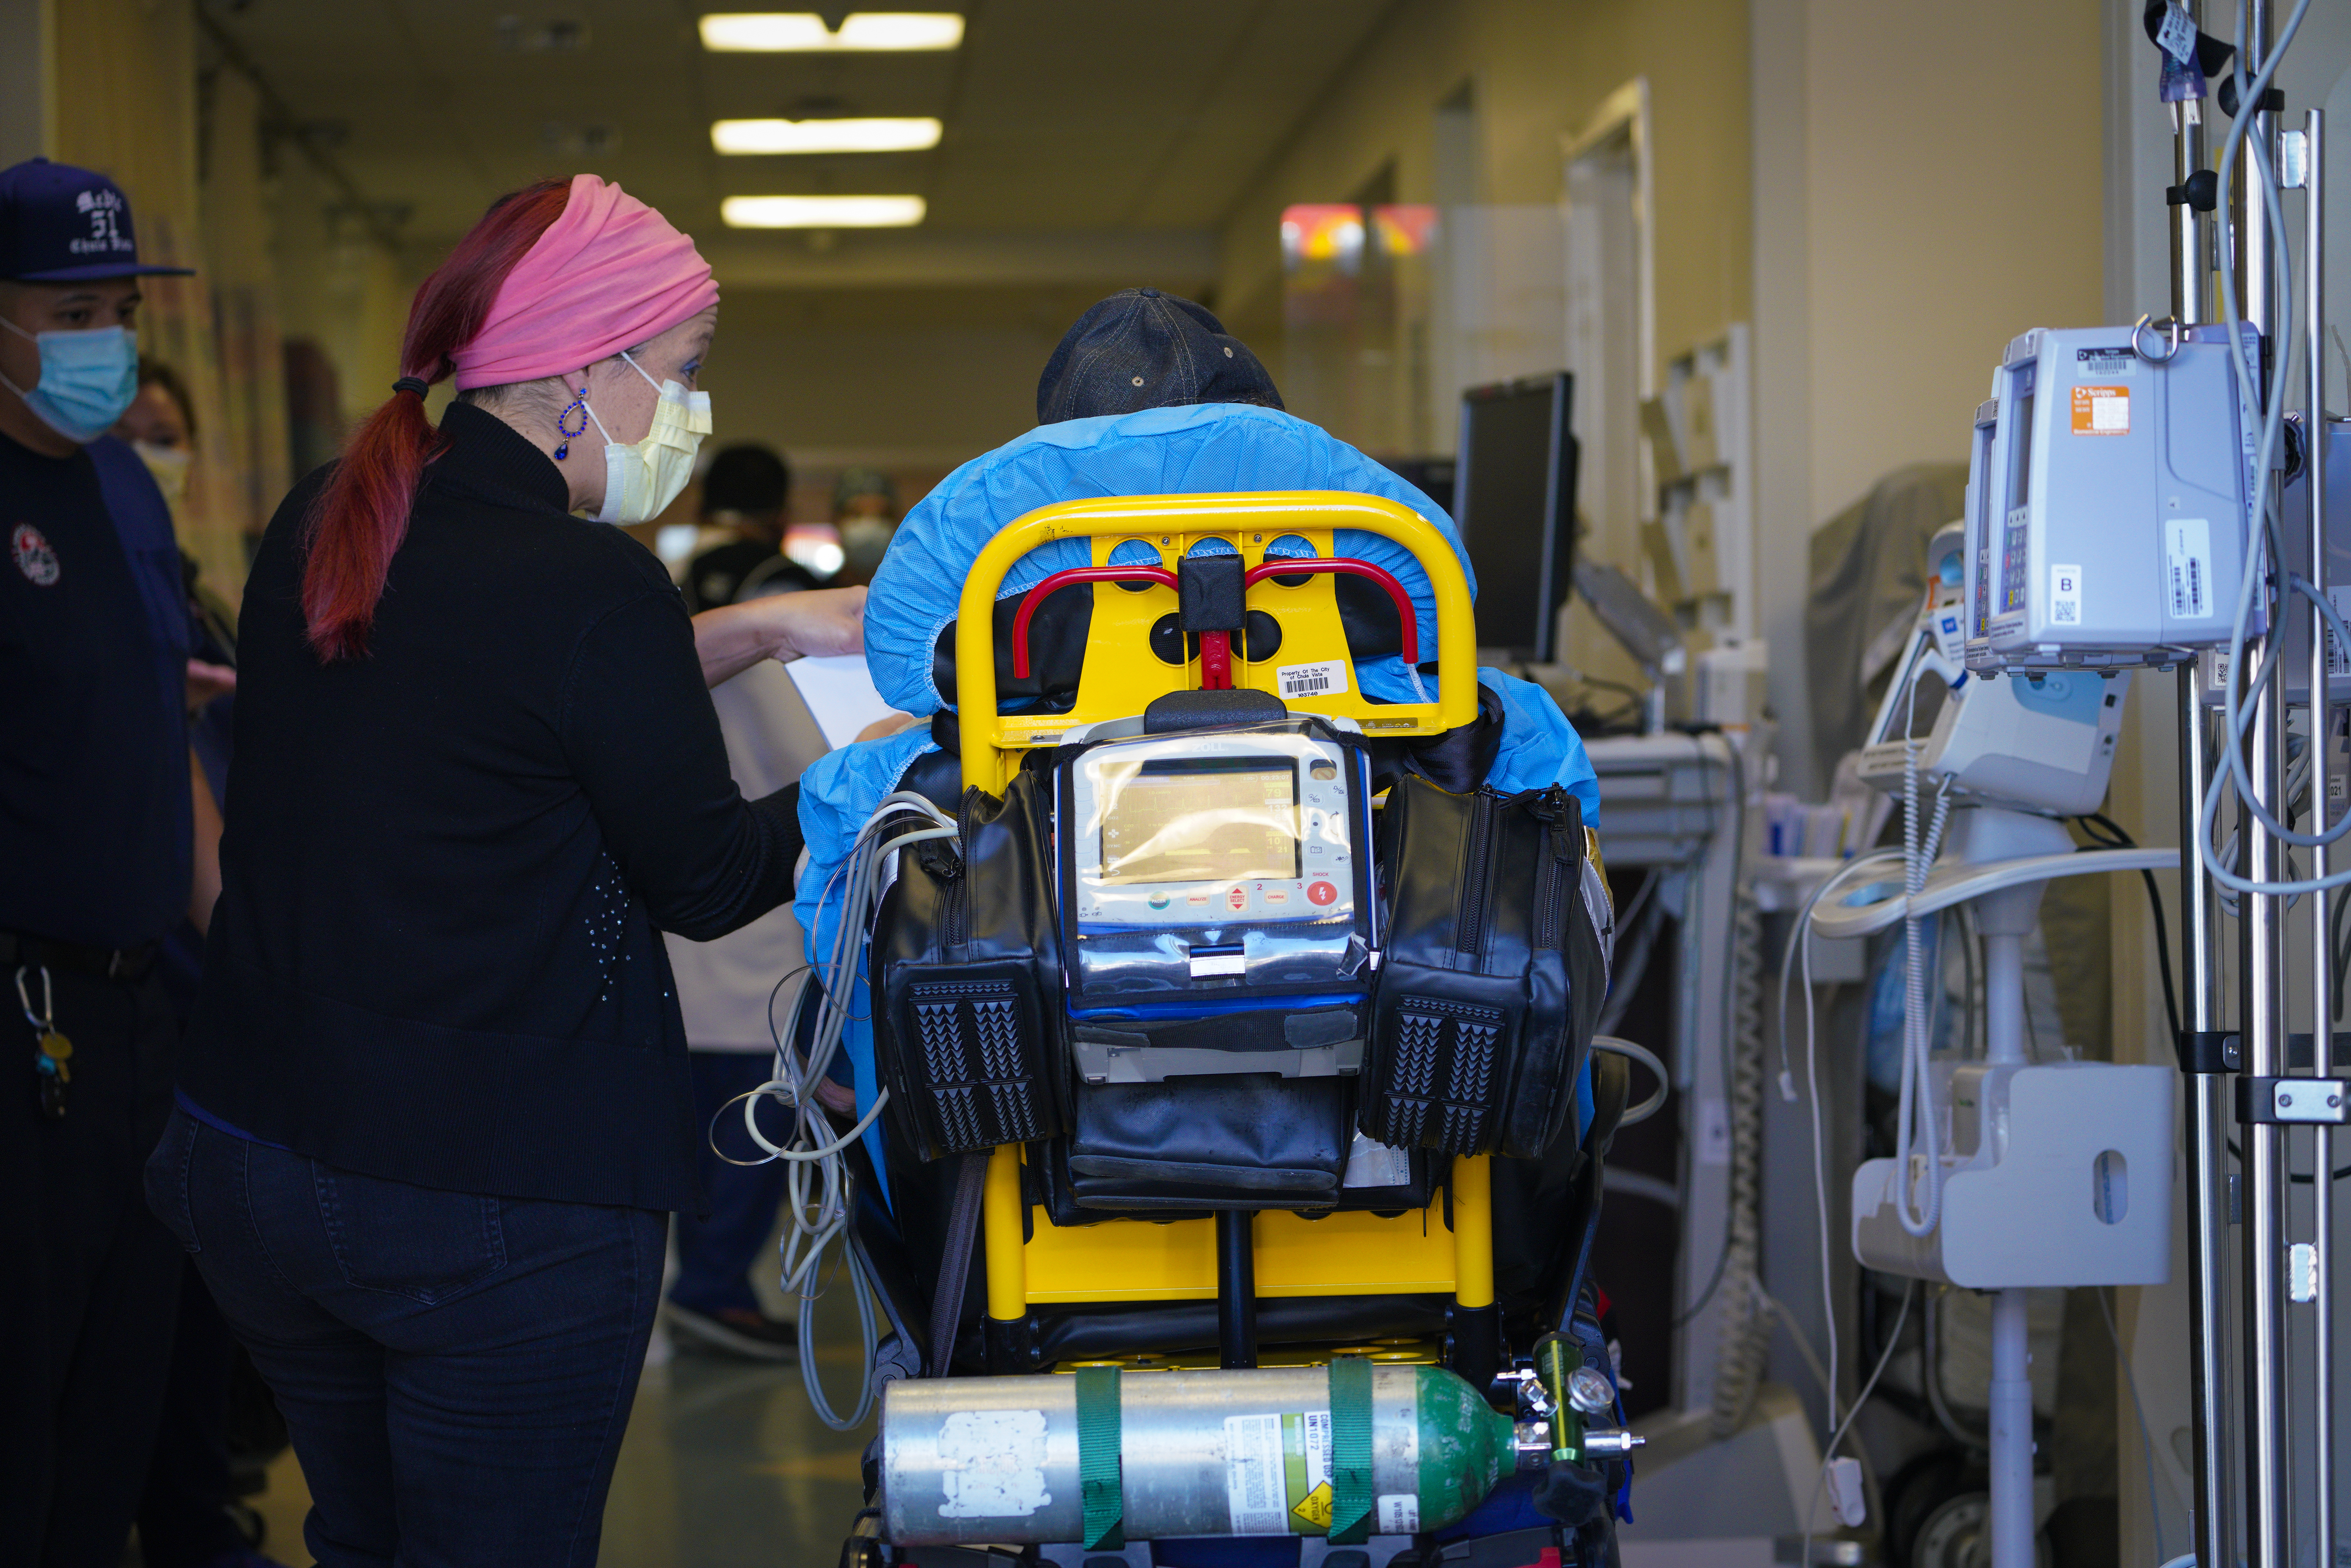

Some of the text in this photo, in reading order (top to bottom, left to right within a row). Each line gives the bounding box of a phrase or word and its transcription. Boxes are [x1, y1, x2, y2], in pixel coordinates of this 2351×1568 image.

[2061, 578, 2072, 591] B
[1192, 743, 1225, 752] ZOLL
[1265, 788, 1281, 797] 79
[1268, 804, 1287, 812] 132
[1309, 1415, 1319, 1450] UN1072
[1320, 1414, 1332, 1463] COMPRESSED
[1310, 1496, 1320, 1521] OXYGEN
